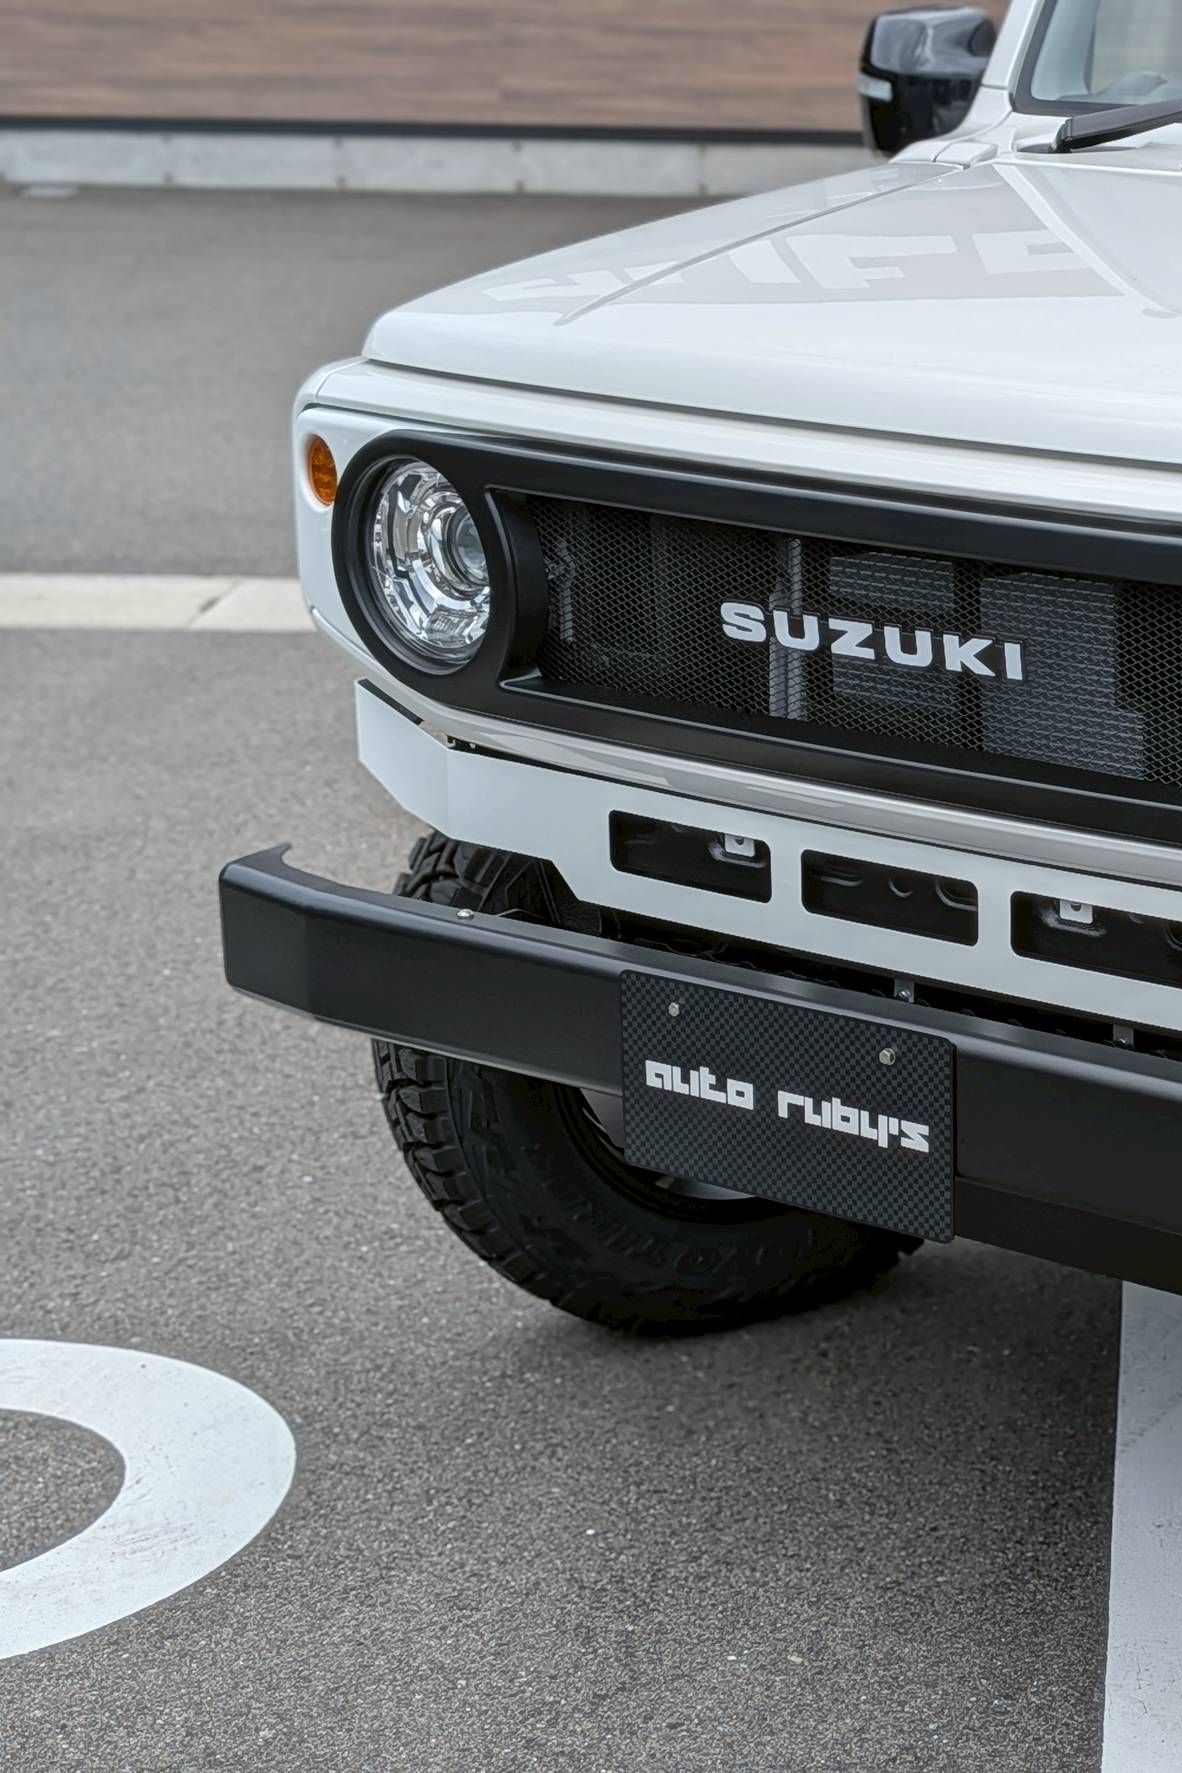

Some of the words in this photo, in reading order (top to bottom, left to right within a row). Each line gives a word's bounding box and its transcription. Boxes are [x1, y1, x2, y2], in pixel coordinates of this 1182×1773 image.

[720, 602, 1023, 681] SUZUKI
[645, 1059, 754, 1111] auto
[777, 1090, 930, 1153] ruby's
